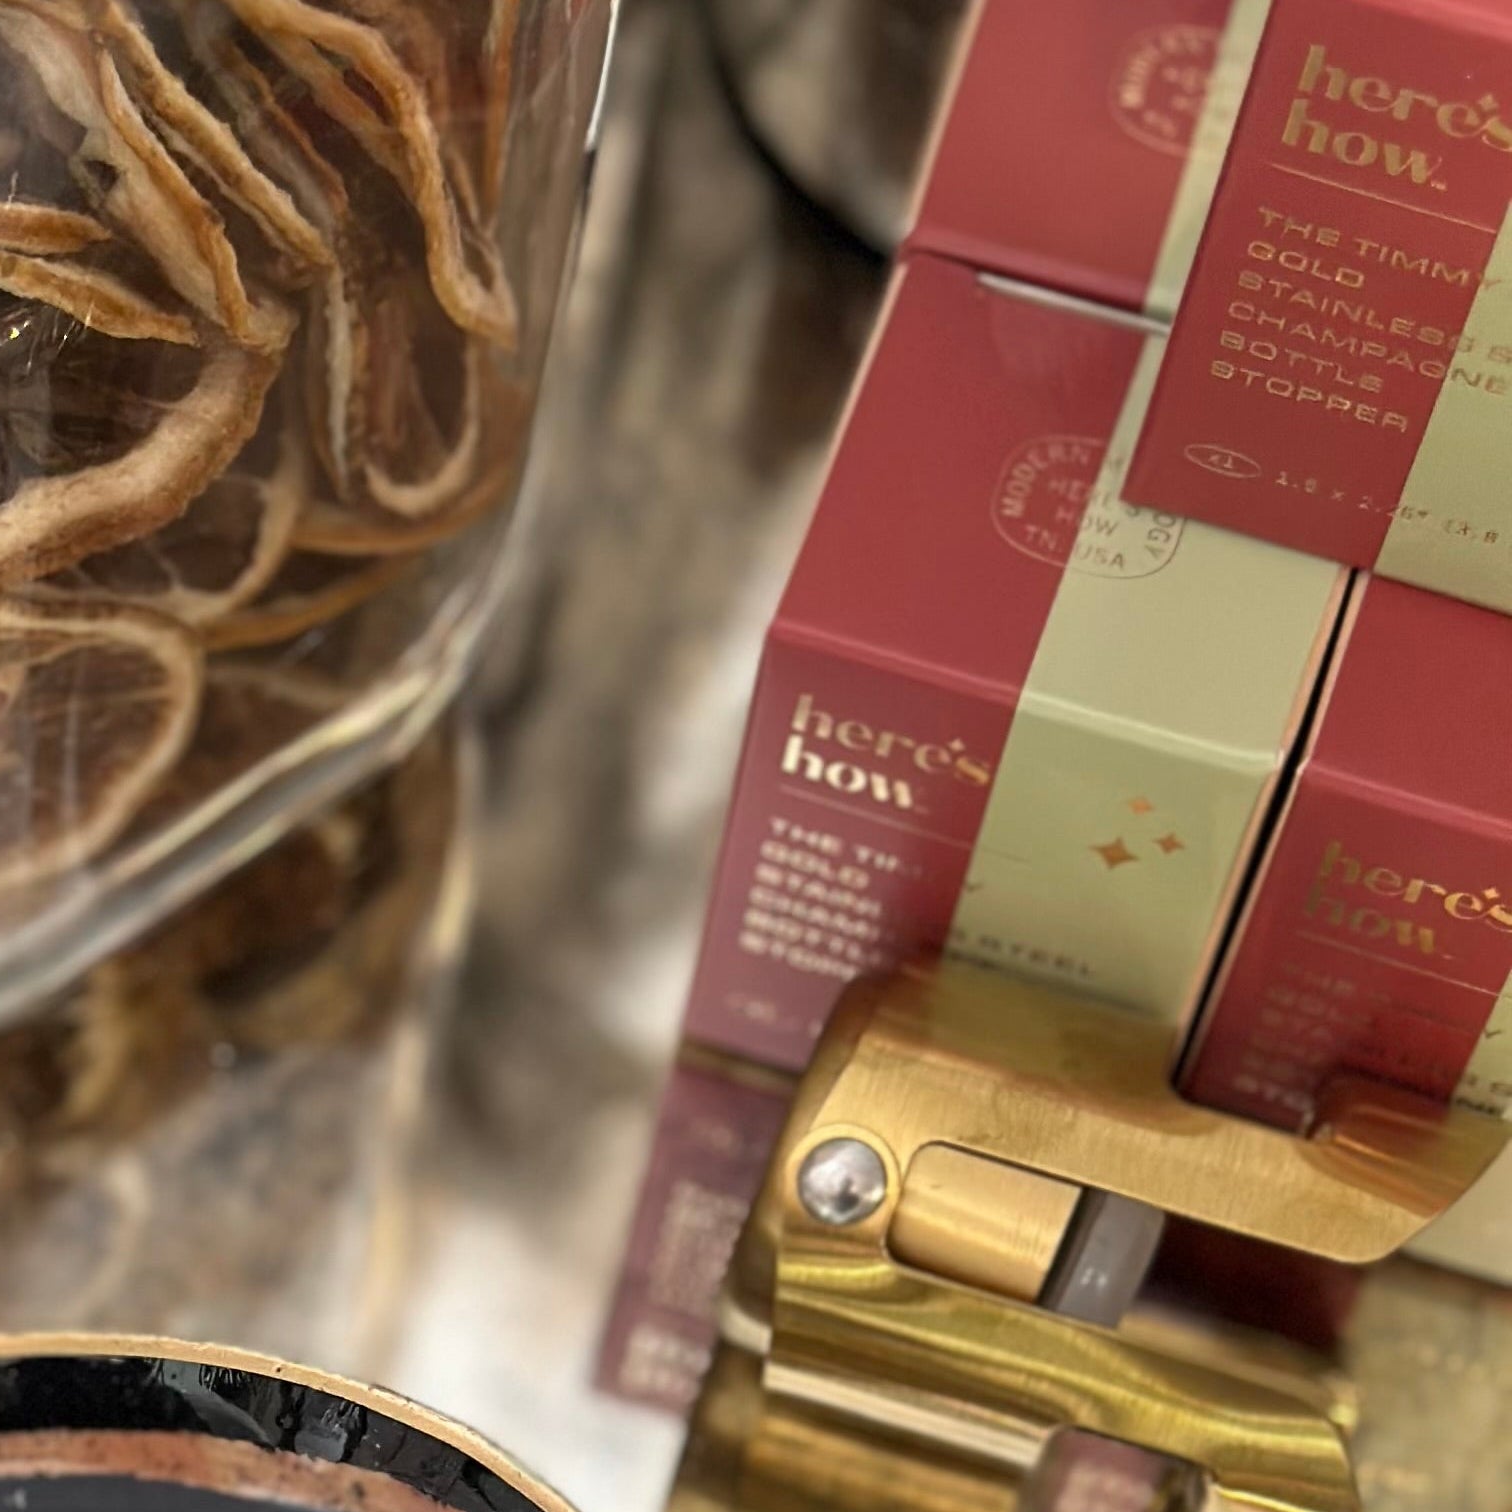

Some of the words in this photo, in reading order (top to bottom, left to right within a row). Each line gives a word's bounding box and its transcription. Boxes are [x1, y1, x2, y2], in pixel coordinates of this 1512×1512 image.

[1298, 44, 1512, 153] here's
[1247, 240, 1365, 288] GOLD
[1258, 206, 1340, 247] THE
[1355, 238, 1502, 290] TIMMY
[1228, 301, 1508, 396] CHAMPAGNE
[1238, 269, 1475, 353] STAINLESS
[1211, 360, 1408, 433] STOPPER
[1219, 330, 1384, 394] BOTTLE
[1075, 544, 1127, 571] USA
[792, 694, 990, 787] here's
[1321, 841, 1512, 933] here's
